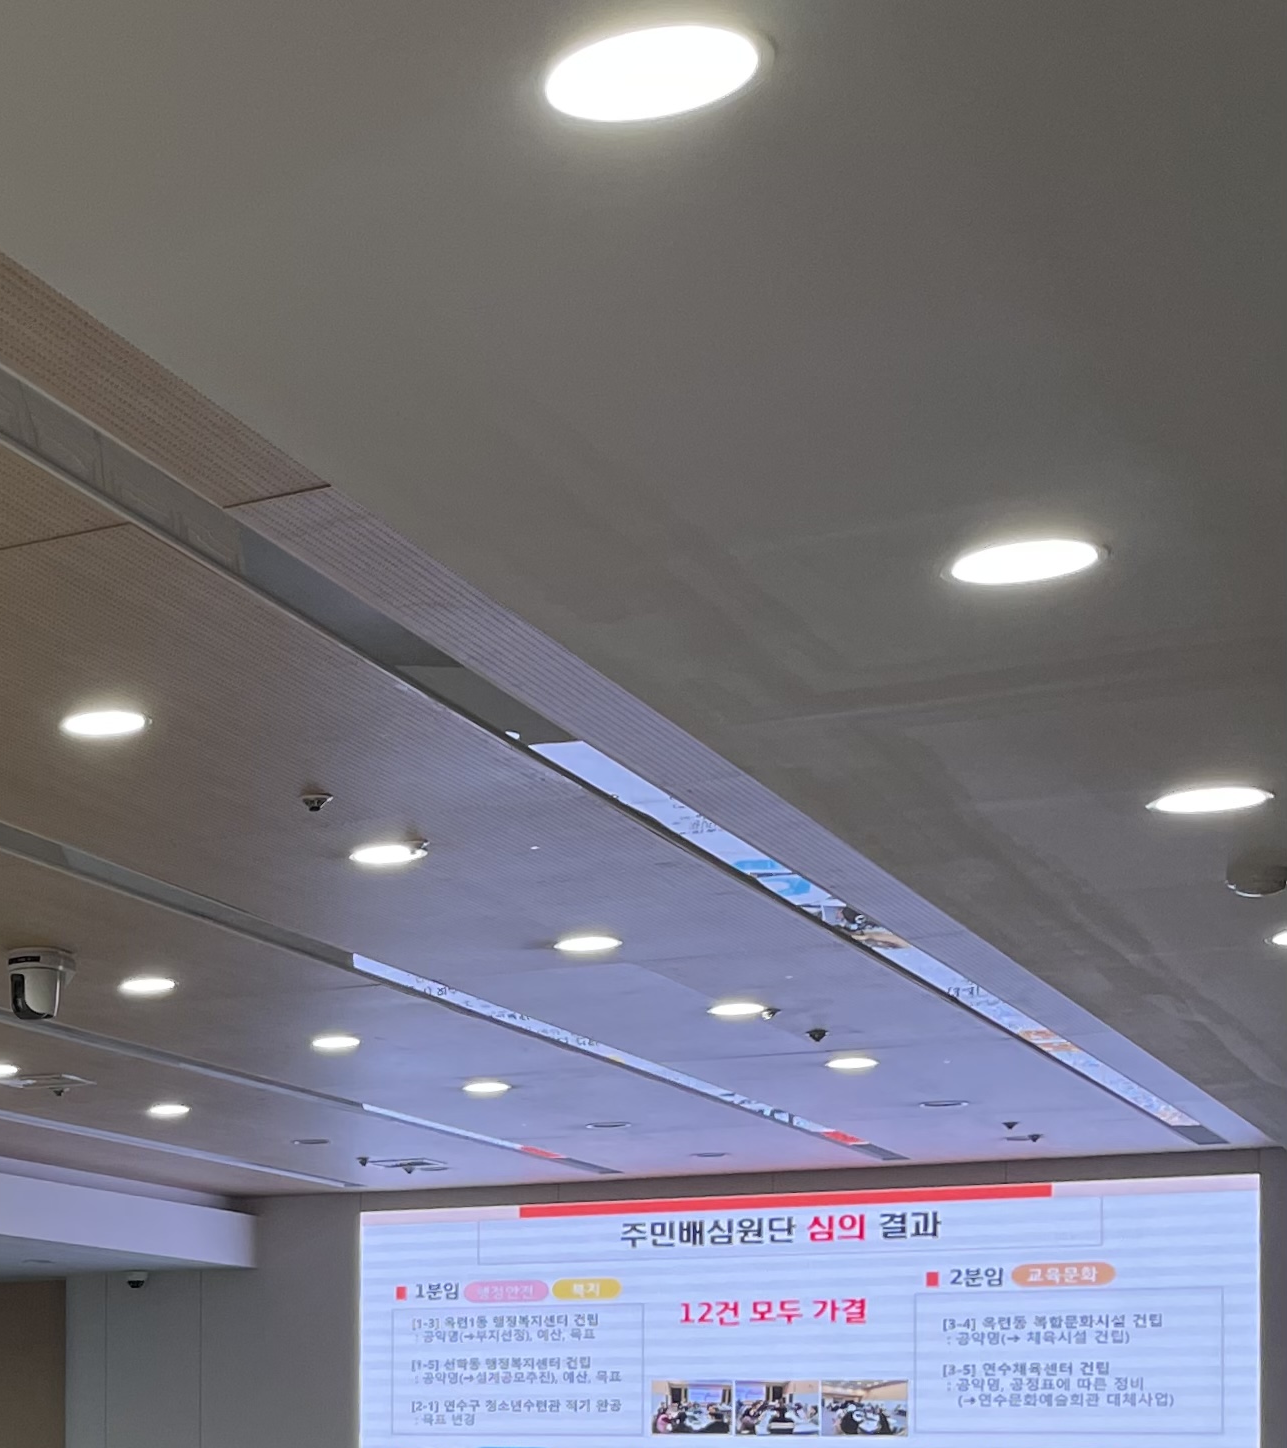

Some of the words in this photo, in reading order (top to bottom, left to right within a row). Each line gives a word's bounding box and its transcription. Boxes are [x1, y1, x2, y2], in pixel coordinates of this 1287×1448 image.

[620, 1216, 796, 1249] 주민배심원단
[807, 1214, 865, 1242] 심의
[879, 1211, 941, 1239] 결과
[950, 1267, 1003, 1287] 2분임
[1027, 1266, 1098, 1284] 교육문화
[415, 1282, 460, 1300] 1분임
[680, 1301, 740, 1327] 12건
[750, 1299, 803, 1324] 모두
[813, 1298, 867, 1323] 가결
[942, 1317, 976, 1331] [3-4]
[982, 1315, 1027, 1330] 옥련동
[1033, 1314, 1126, 1329] 복합문화시설
[1133, 1313, 1163, 1328] 건립
[1027, 1330, 1087, 1345] 체육시설
[942, 1364, 976, 1377] [3-5]
[983, 1362, 1073, 1376] 연수체육센터
[1080, 1361, 1110, 1375] 건립
[1010, 1377, 1070, 1391] 공정표에
[1077, 1377, 1107, 1390] 따른
[1114, 1376, 1144, 1391] 정비
